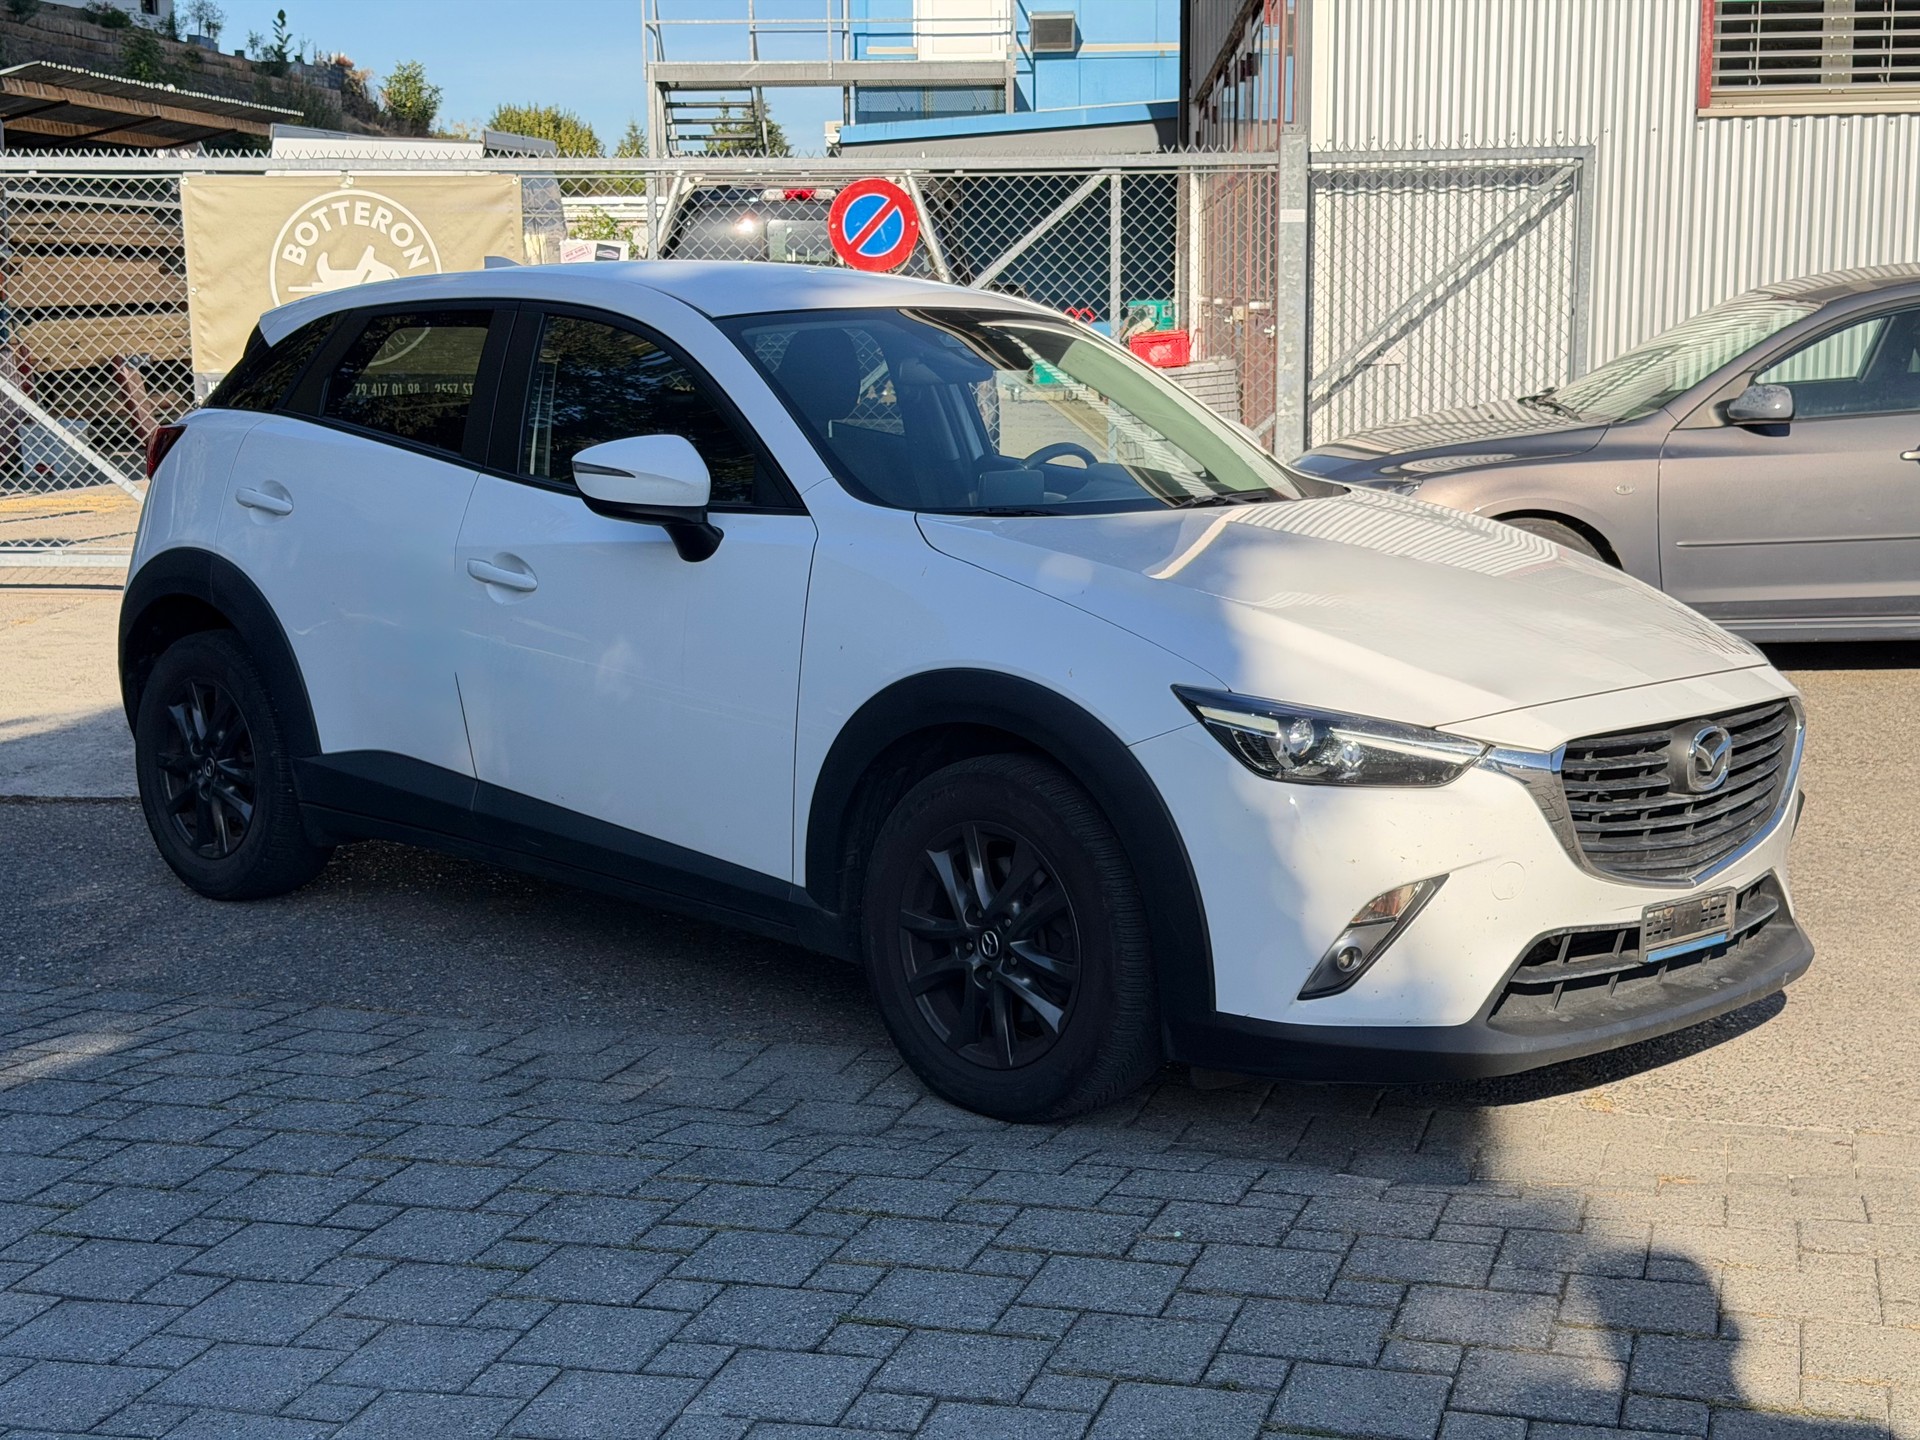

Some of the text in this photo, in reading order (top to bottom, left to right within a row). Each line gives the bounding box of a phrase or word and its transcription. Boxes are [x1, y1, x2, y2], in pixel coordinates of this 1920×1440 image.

[282, 200, 430, 270] BOTTERON
[371, 383, 388, 396] 417
[391, 383, 403, 395] 01
[407, 383, 420, 394] 98
